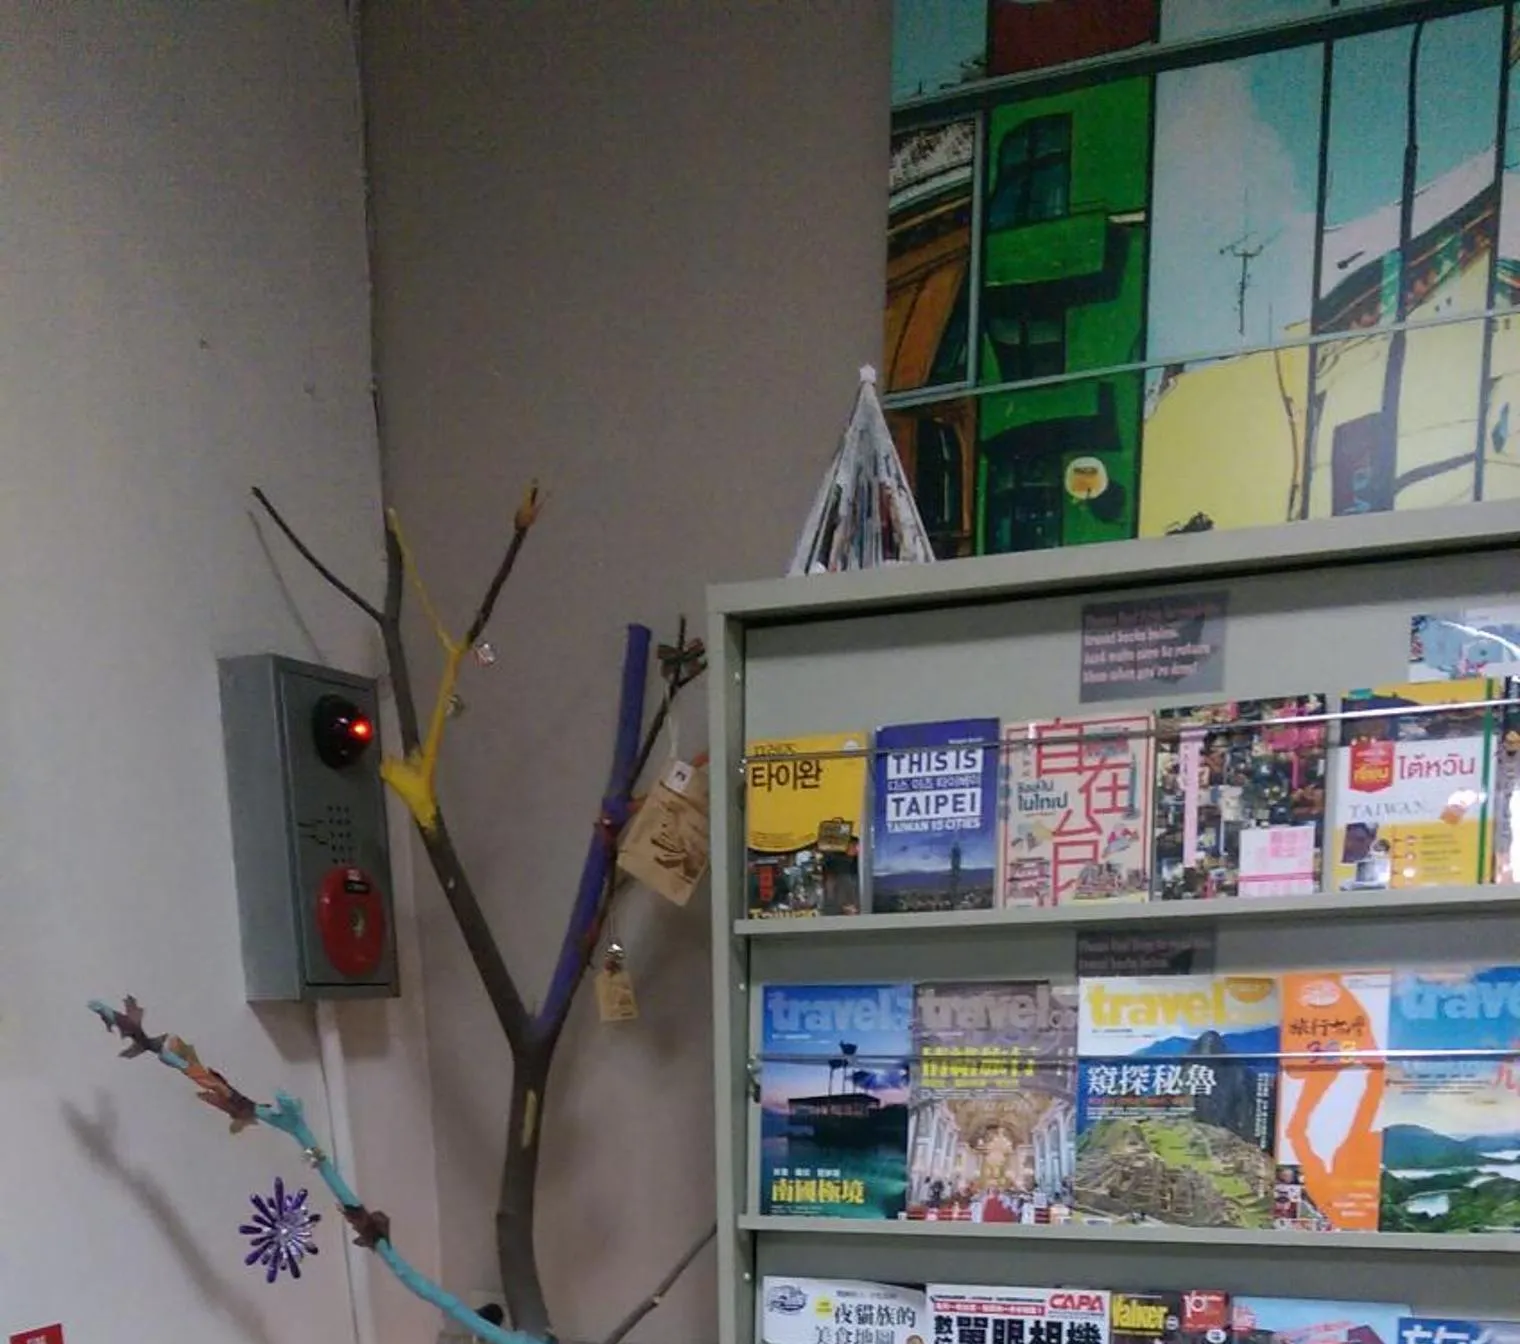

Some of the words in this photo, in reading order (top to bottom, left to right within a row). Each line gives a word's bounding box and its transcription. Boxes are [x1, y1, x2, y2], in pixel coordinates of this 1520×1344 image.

[892, 751, 947, 774] THIS
[956, 749, 976, 769] IS
[1398, 753, 1476, 780] ไต้หวัน
[751, 759, 822, 792] 타이완
[892, 792, 975, 817] TAIPEI
[1050, 1293, 1104, 1312] CAPA
